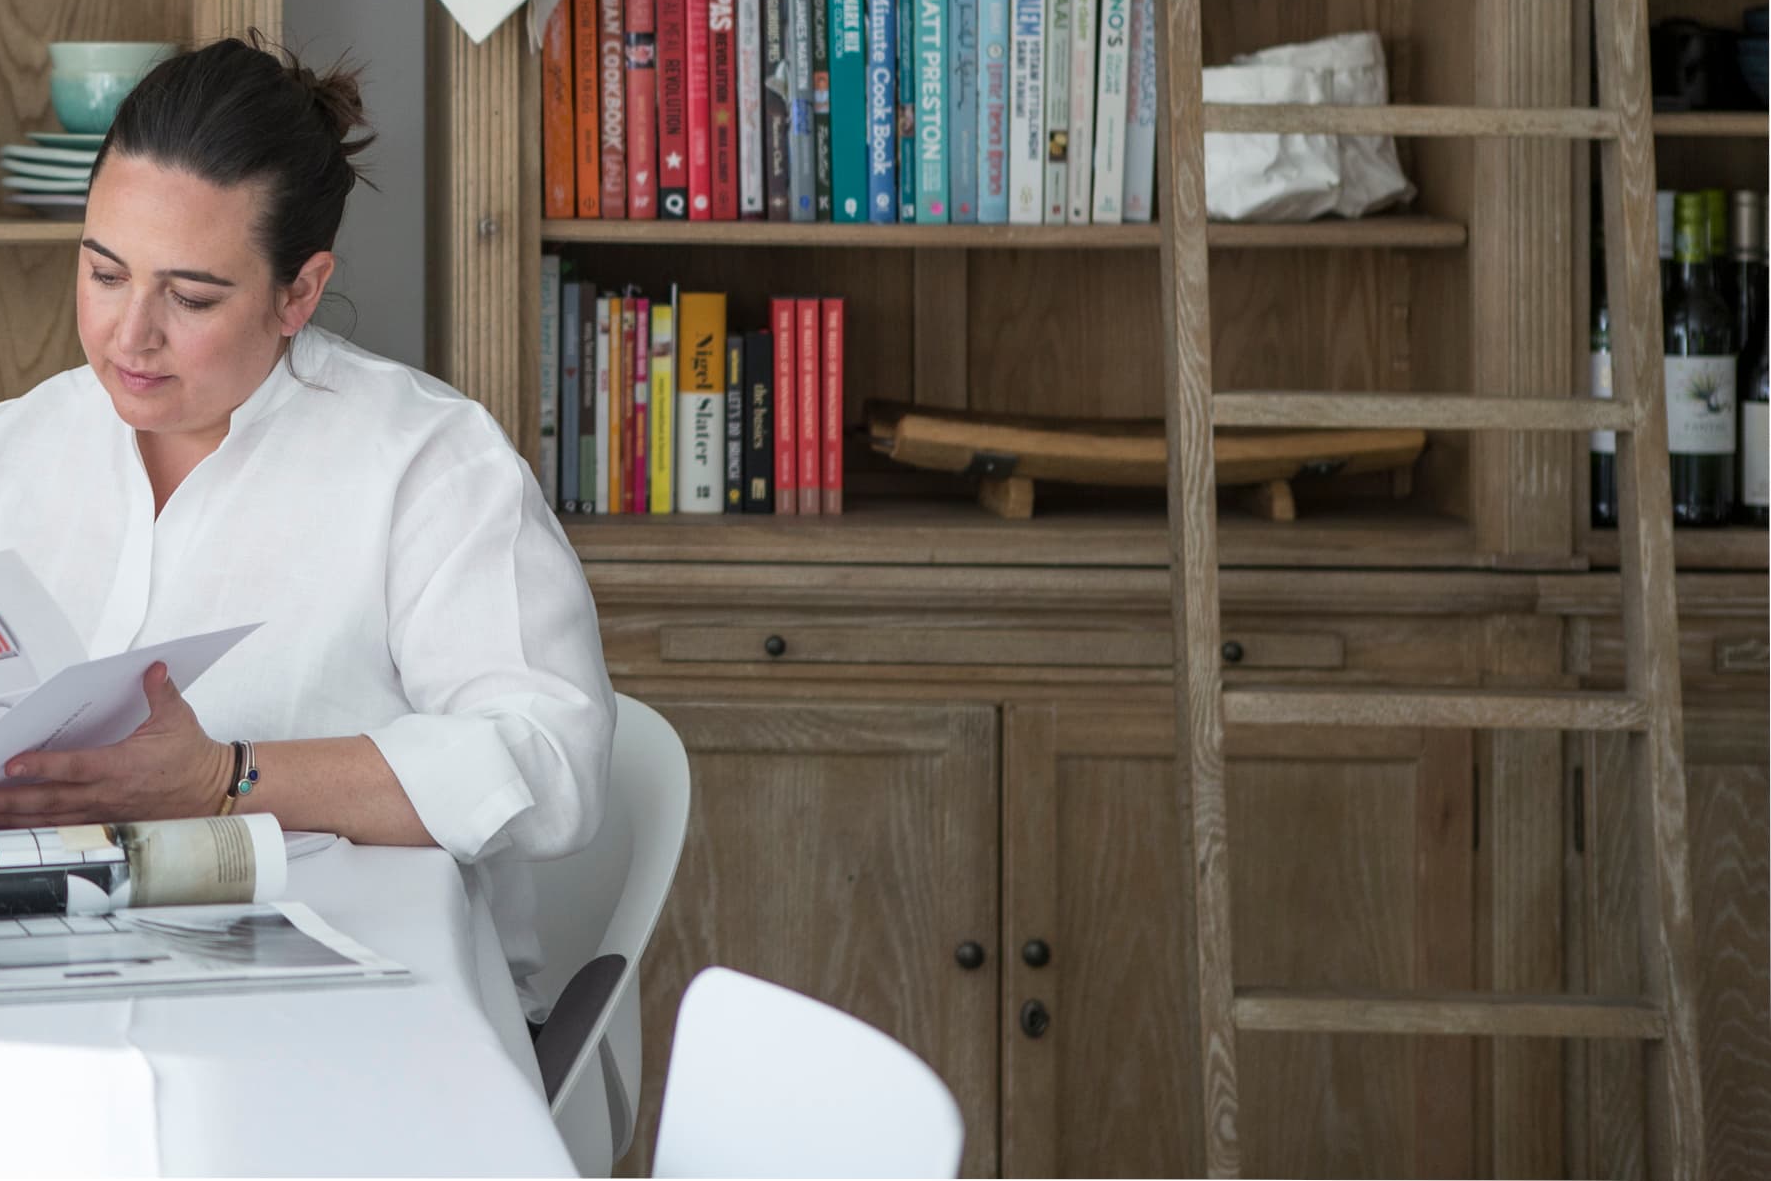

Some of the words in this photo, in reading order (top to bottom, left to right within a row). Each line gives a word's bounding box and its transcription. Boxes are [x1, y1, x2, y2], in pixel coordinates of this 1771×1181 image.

[797, 41, 809, 90] MARTIN
[844, 30, 860, 52] HIX
[1029, 40, 1040, 81] YOTAM
[716, 33, 729, 104] REVOLUTION
[872, 67, 892, 121] Cook
[602, 40, 623, 151] COOKBOOK
[665, 59, 682, 135] REVOLUTION
[922, 50, 941, 160] PRESTON
[1028, 84, 1040, 160] OTTOLENGHI
[873, 123, 892, 175] Book
[693, 333, 714, 390] Nigel
[728, 390, 741, 418] LET'S
[753, 383, 768, 404] the
[695, 398, 715, 466] Slater
[728, 421, 741, 436] DO
[753, 408, 768, 450] basics
[728, 440, 741, 481] BRUNCH
